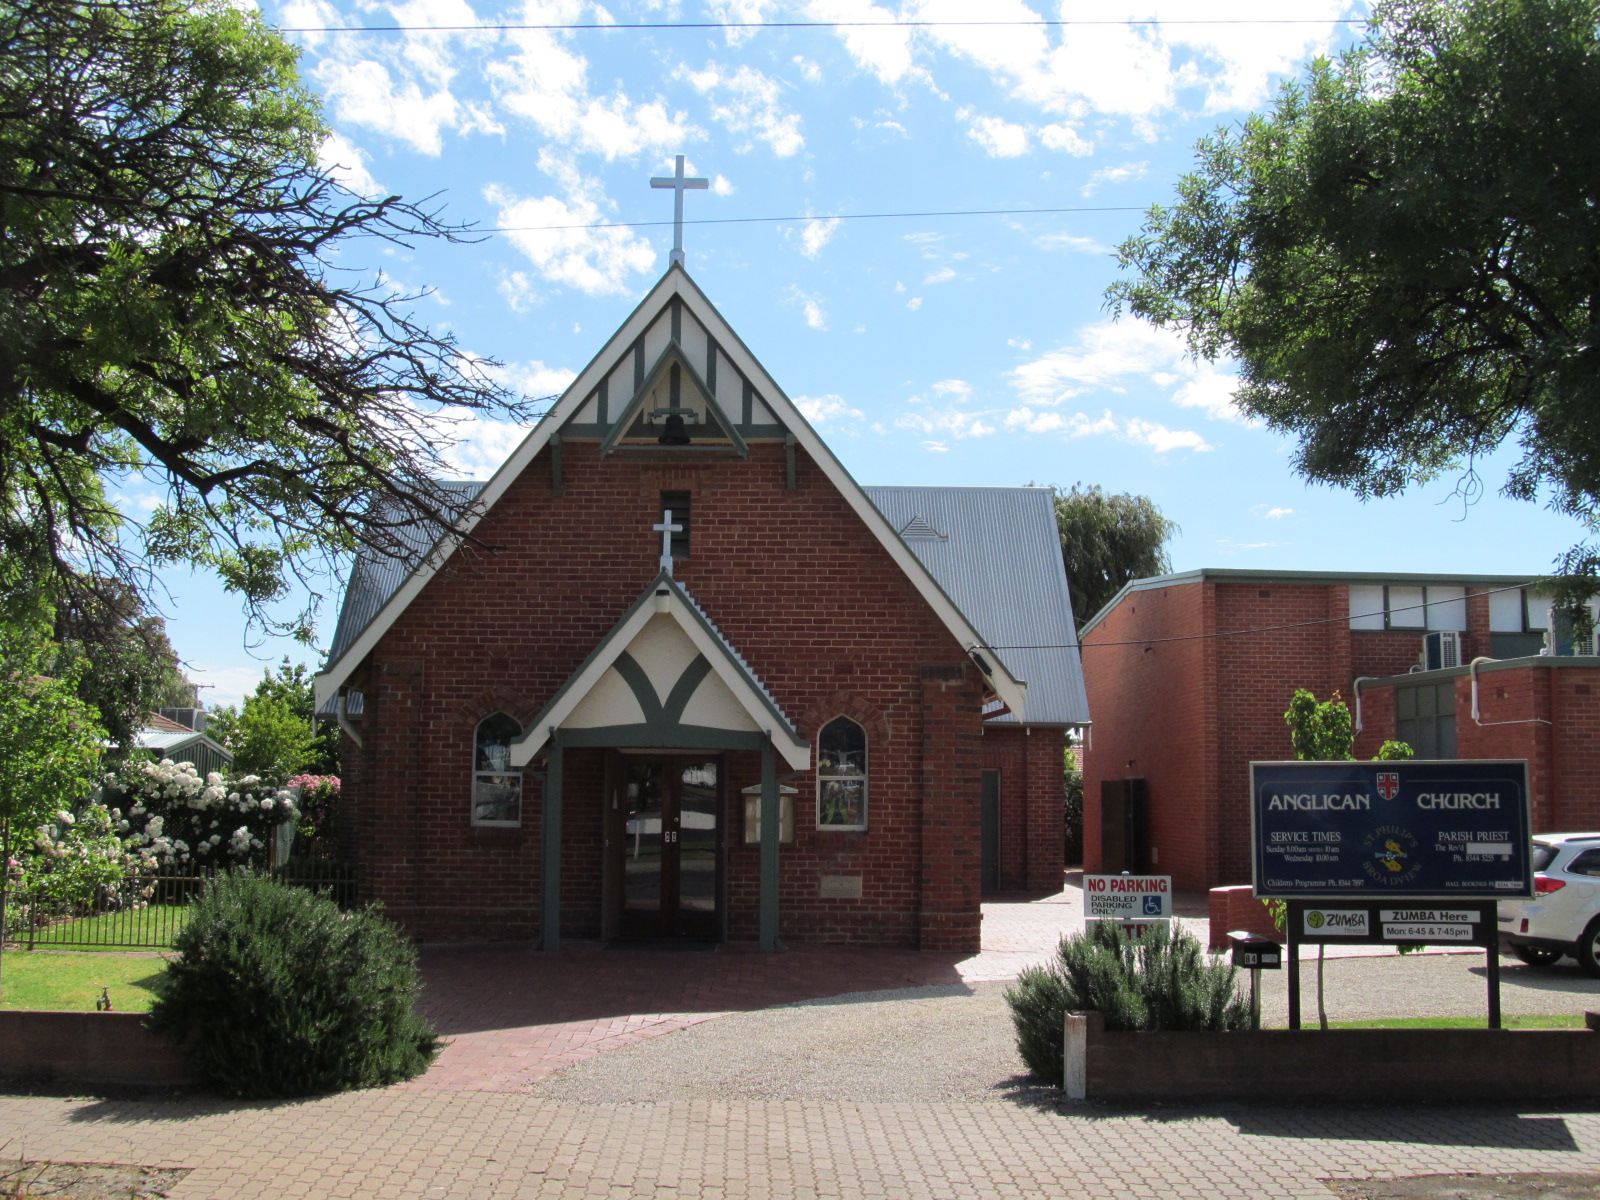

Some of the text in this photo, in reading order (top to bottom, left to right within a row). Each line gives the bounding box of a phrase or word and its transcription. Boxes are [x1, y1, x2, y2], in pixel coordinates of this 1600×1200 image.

[1268, 793, 1500, 810] ANGLICAN CHURCH
[1270, 832, 1341, 842] SERVICE TIMES
[1438, 832, 1510, 841] PARISH PRIEST
[1266, 845, 1285, 854] Sunday
[1435, 844, 1464, 852] The Rev'd
[1284, 854, 1313, 863] Wednesday
[1088, 878, 1168, 893] NO PARKING
[1295, 879, 1327, 888] Programme
[1091, 895, 1137, 903] DISABLED
[1091, 901, 1132, 909] PARKING
[1326, 913, 1366, 927] ZUMBA
[1392, 911, 1468, 921] ZUMBA Here
[1386, 927, 1407, 936] Mon:
[1428, 928, 1435, 936] &
